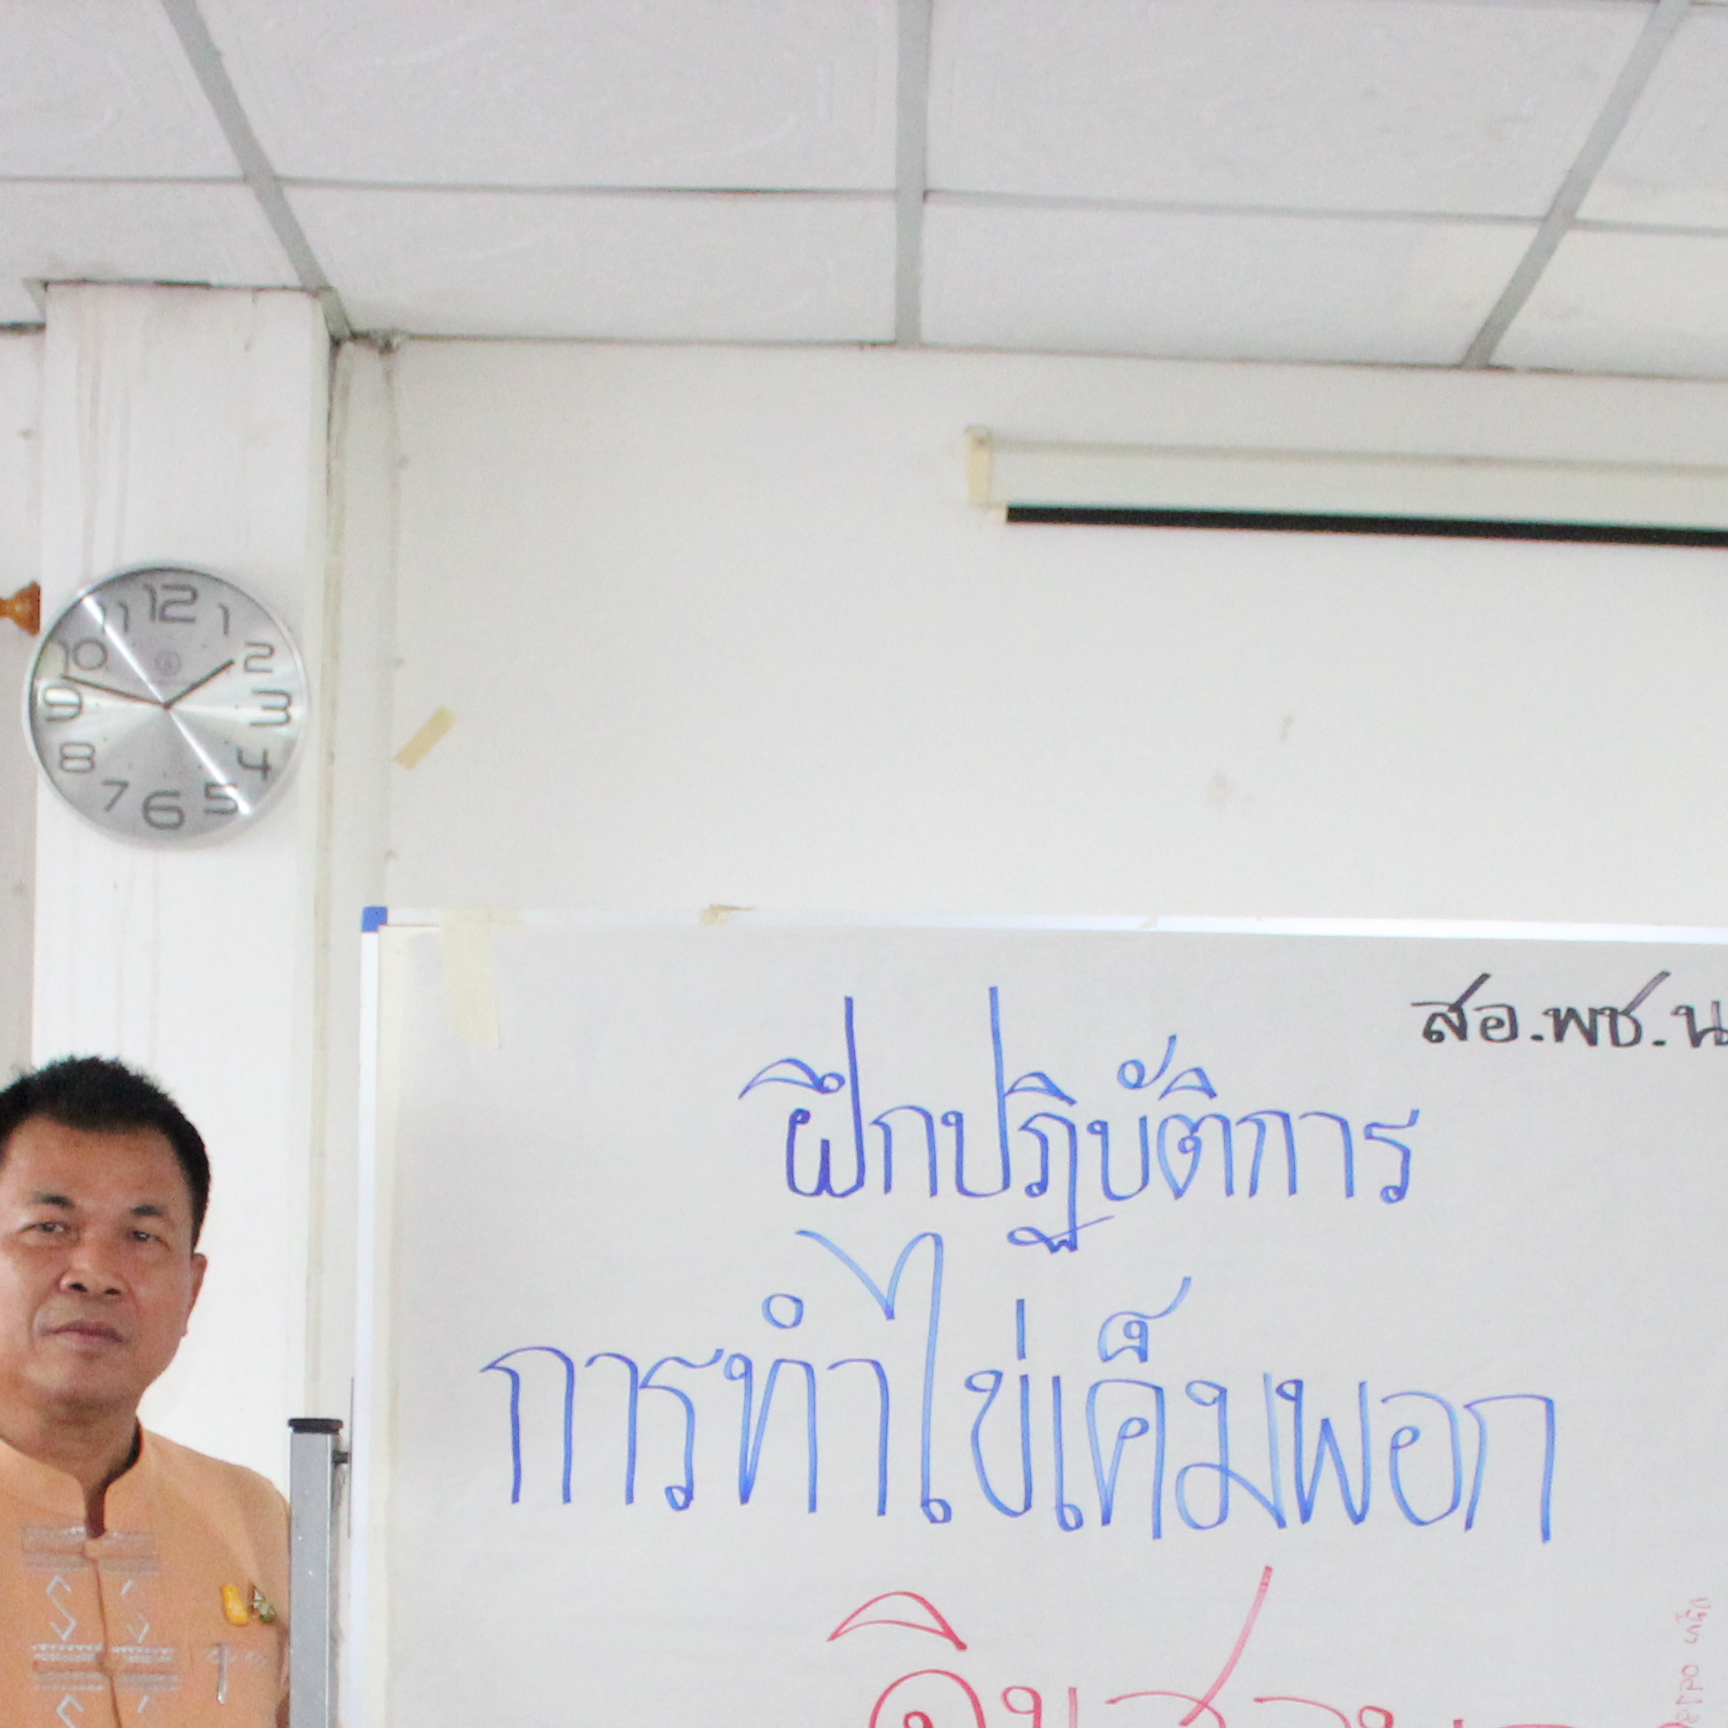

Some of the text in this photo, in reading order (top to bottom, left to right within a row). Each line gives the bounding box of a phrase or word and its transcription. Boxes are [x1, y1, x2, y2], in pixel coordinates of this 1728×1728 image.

[142, 583, 198, 623] 12
[218, 603, 230, 634] 1
[56, 638, 109, 677] 10
[243, 641, 274, 673] 2
[43, 685, 83, 722] 9
[249, 687, 292, 727] 3
[59, 742, 95, 773] 8
[236, 747, 271, 781] 4
[102, 780, 129, 812] 7
[142, 790, 185, 830] 6
[203, 782, 238, 815] 5
[737, 985, 1421, 1256] ฝึกปฏิบัติการ
[479, 1229, 1557, 1544] การทำไข่เค็มพอก
